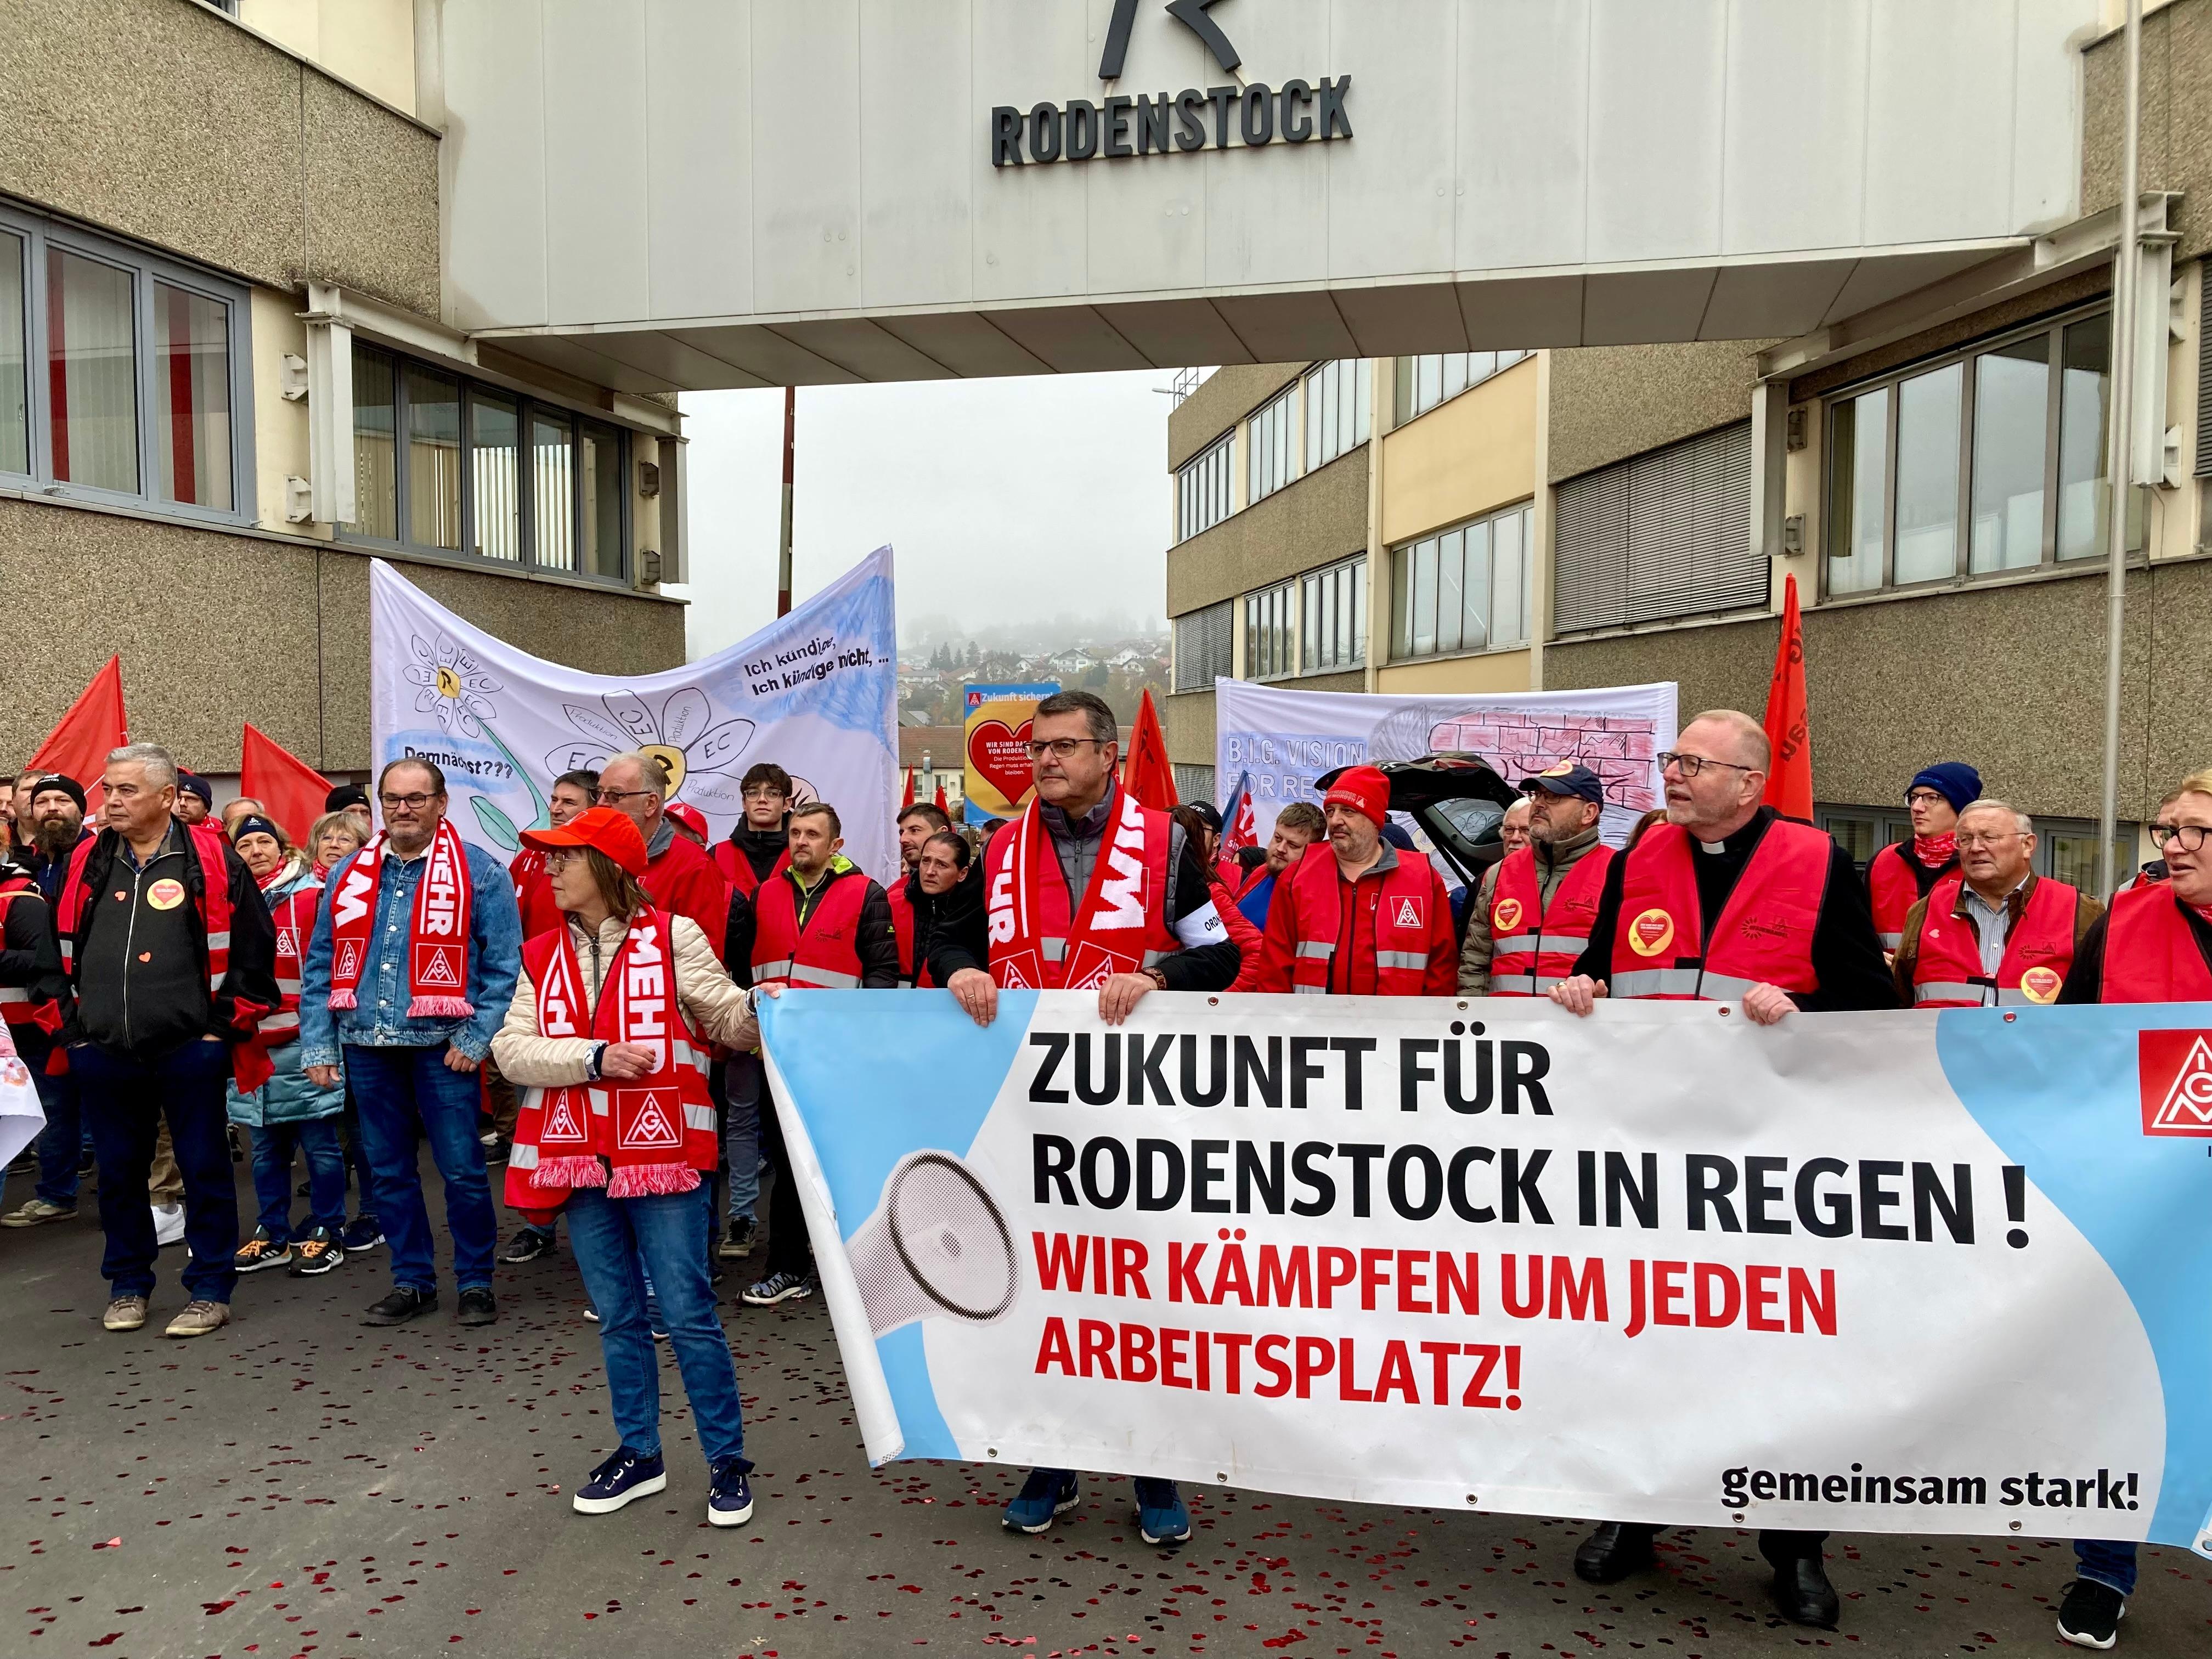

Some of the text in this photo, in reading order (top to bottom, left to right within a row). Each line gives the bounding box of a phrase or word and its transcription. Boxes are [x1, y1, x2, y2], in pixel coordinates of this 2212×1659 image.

[992, 75, 1353, 167] RODENSTOCK
[744, 636, 836, 677] Ich kündige,
[752, 679, 780, 696] Ich
[782, 661, 834, 689] kündige
[837, 646, 872, 669] nicht,
[465, 695, 483, 710] EC
[470, 679, 490, 689] EC
[981, 692, 1018, 703] Zukunft
[457, 705, 473, 725] EC
[569, 708, 618, 740] Produktion
[619, 709, 653, 735] EC
[668, 706, 692, 743] Produktion
[704, 732, 731, 759] EC
[1228, 737, 1364, 768] B.I.G. VISION
[687, 779, 735, 802] Produktion
[426, 838, 456, 936] MEHR
[1028, 1020, 1554, 1116] ZUKUNFT FÜR
[1033, 1133, 2030, 1249] RODENSTOCK IN REGEN !
[1032, 1227, 1838, 1339] WIR KÄMPFEN UM JEDEN
[1034, 1316, 1522, 1410] ARBEITSPLATZ!
[1721, 1462, 2139, 1511] gemeinsam stark!
